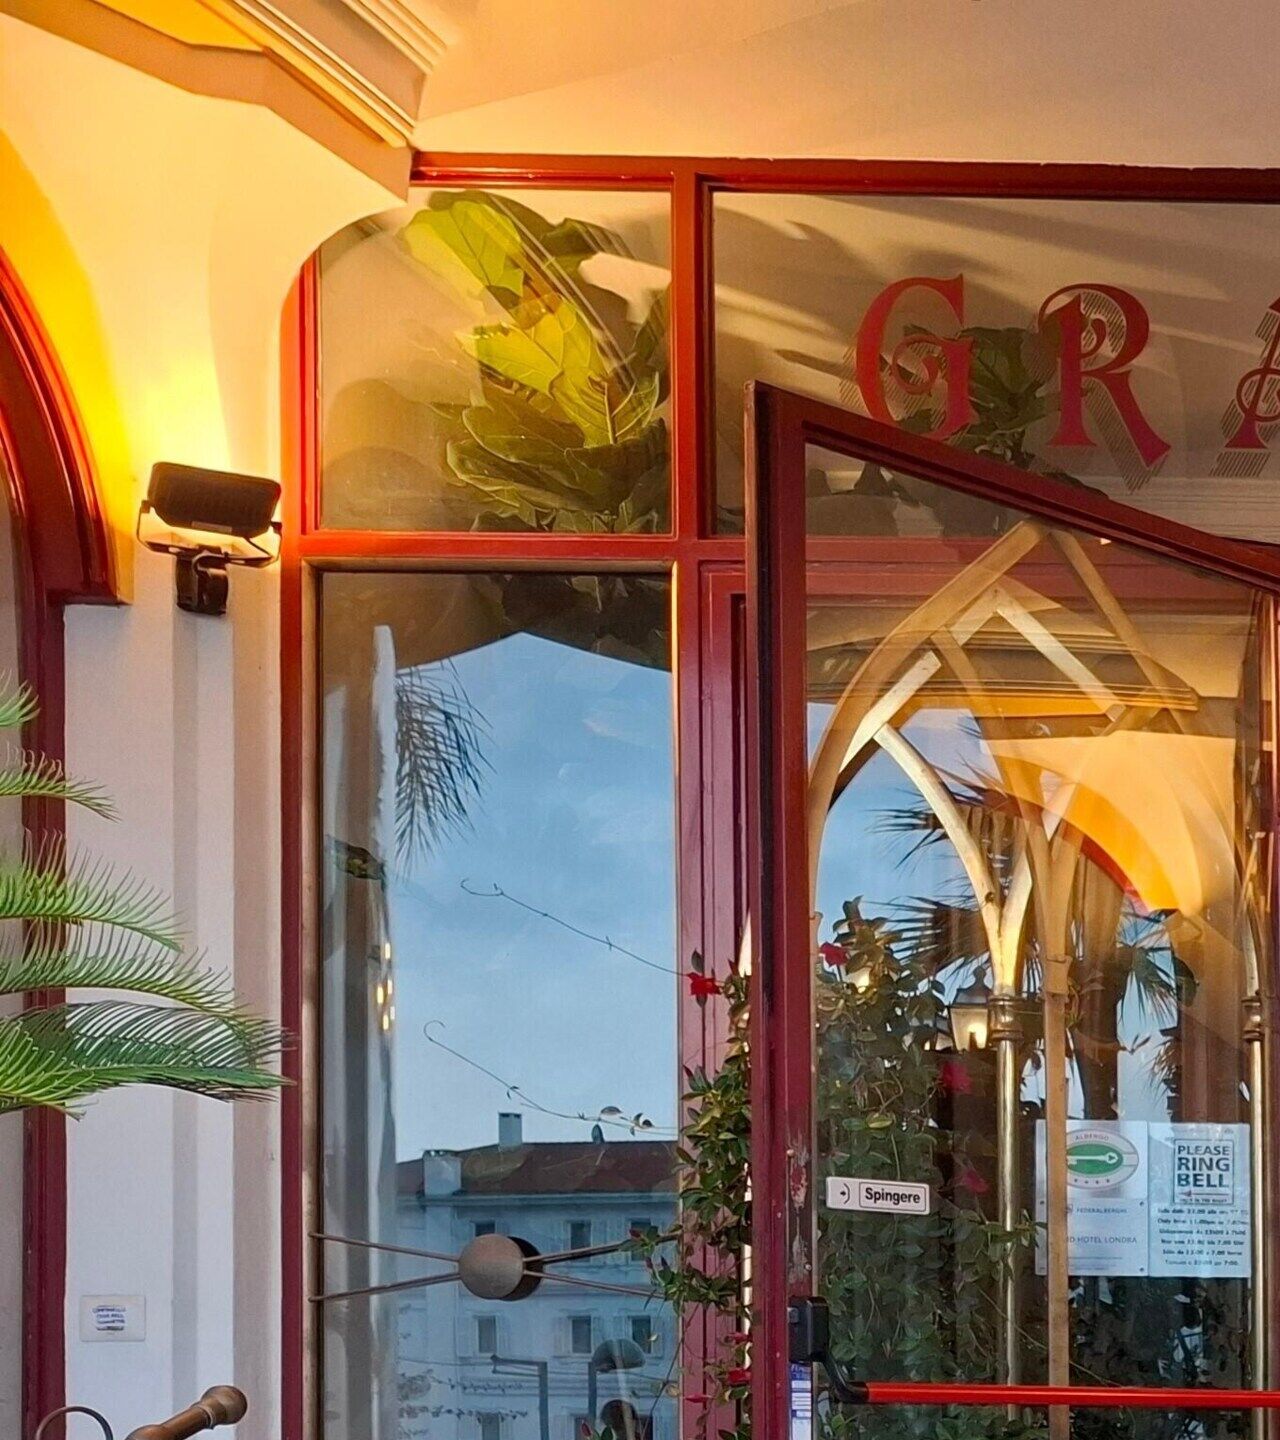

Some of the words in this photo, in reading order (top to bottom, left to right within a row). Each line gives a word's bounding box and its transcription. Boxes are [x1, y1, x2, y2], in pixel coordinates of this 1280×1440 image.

[1177, 1145, 1230, 1156] PLEASE
[1177, 1157, 1230, 1172] RING
[1177, 1173, 1230, 1188] BELL
[865, 1187, 920, 1205] Spingere
[1077, 1236, 1102, 1244] HOTEL
[1104, 1236, 1137, 1244] LONDRA
